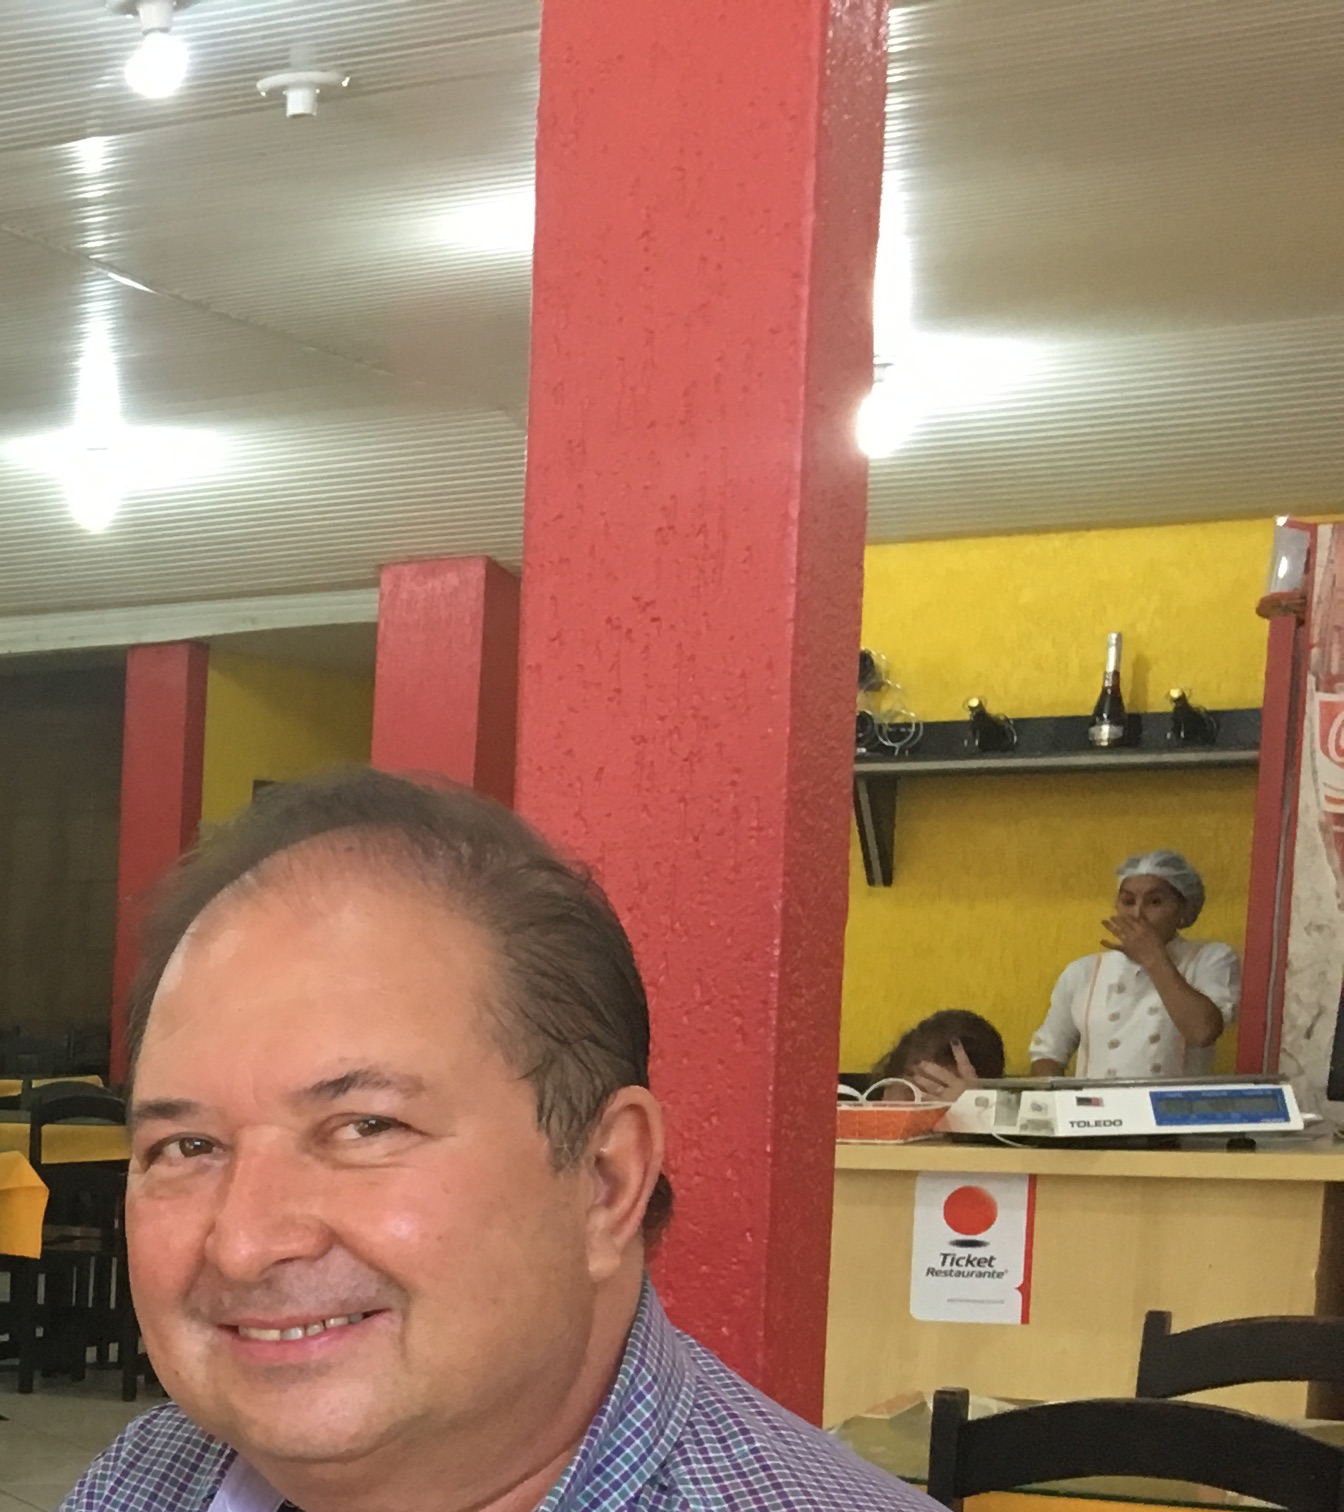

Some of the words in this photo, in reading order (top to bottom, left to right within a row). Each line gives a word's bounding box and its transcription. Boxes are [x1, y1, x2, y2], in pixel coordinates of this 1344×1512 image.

[1068, 1118, 1124, 1129] TOLEDO
[939, 1252, 997, 1269] Ticket
[925, 1266, 1006, 1280] Restaurante
